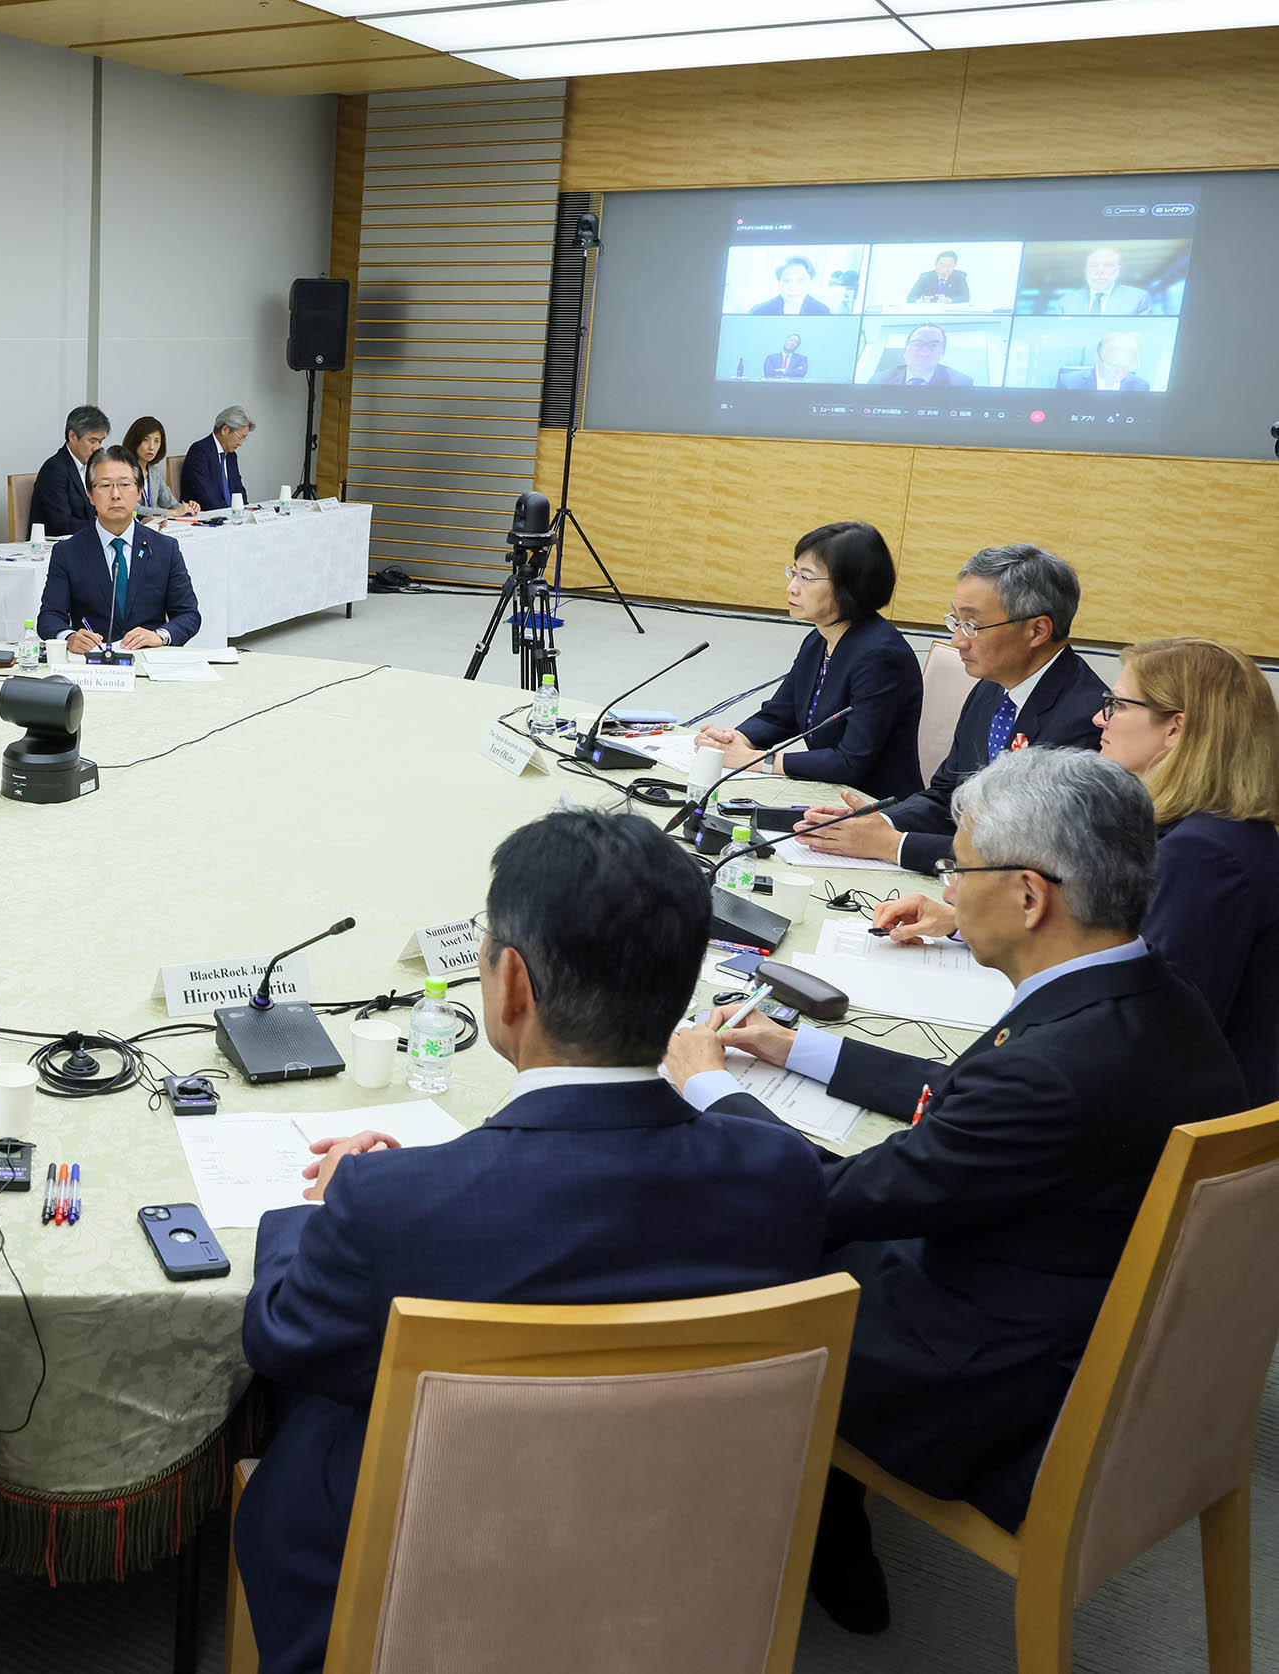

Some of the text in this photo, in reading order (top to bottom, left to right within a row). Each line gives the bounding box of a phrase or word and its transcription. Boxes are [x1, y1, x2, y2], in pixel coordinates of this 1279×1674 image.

[95, 679, 126, 688] Kanda
[425, 922, 470, 939] Sumitomo
[440, 932, 473, 949] Asset M
[189, 966, 248, 981] BlackRock
[183, 980, 297, 1005] Hiroyuki rita
